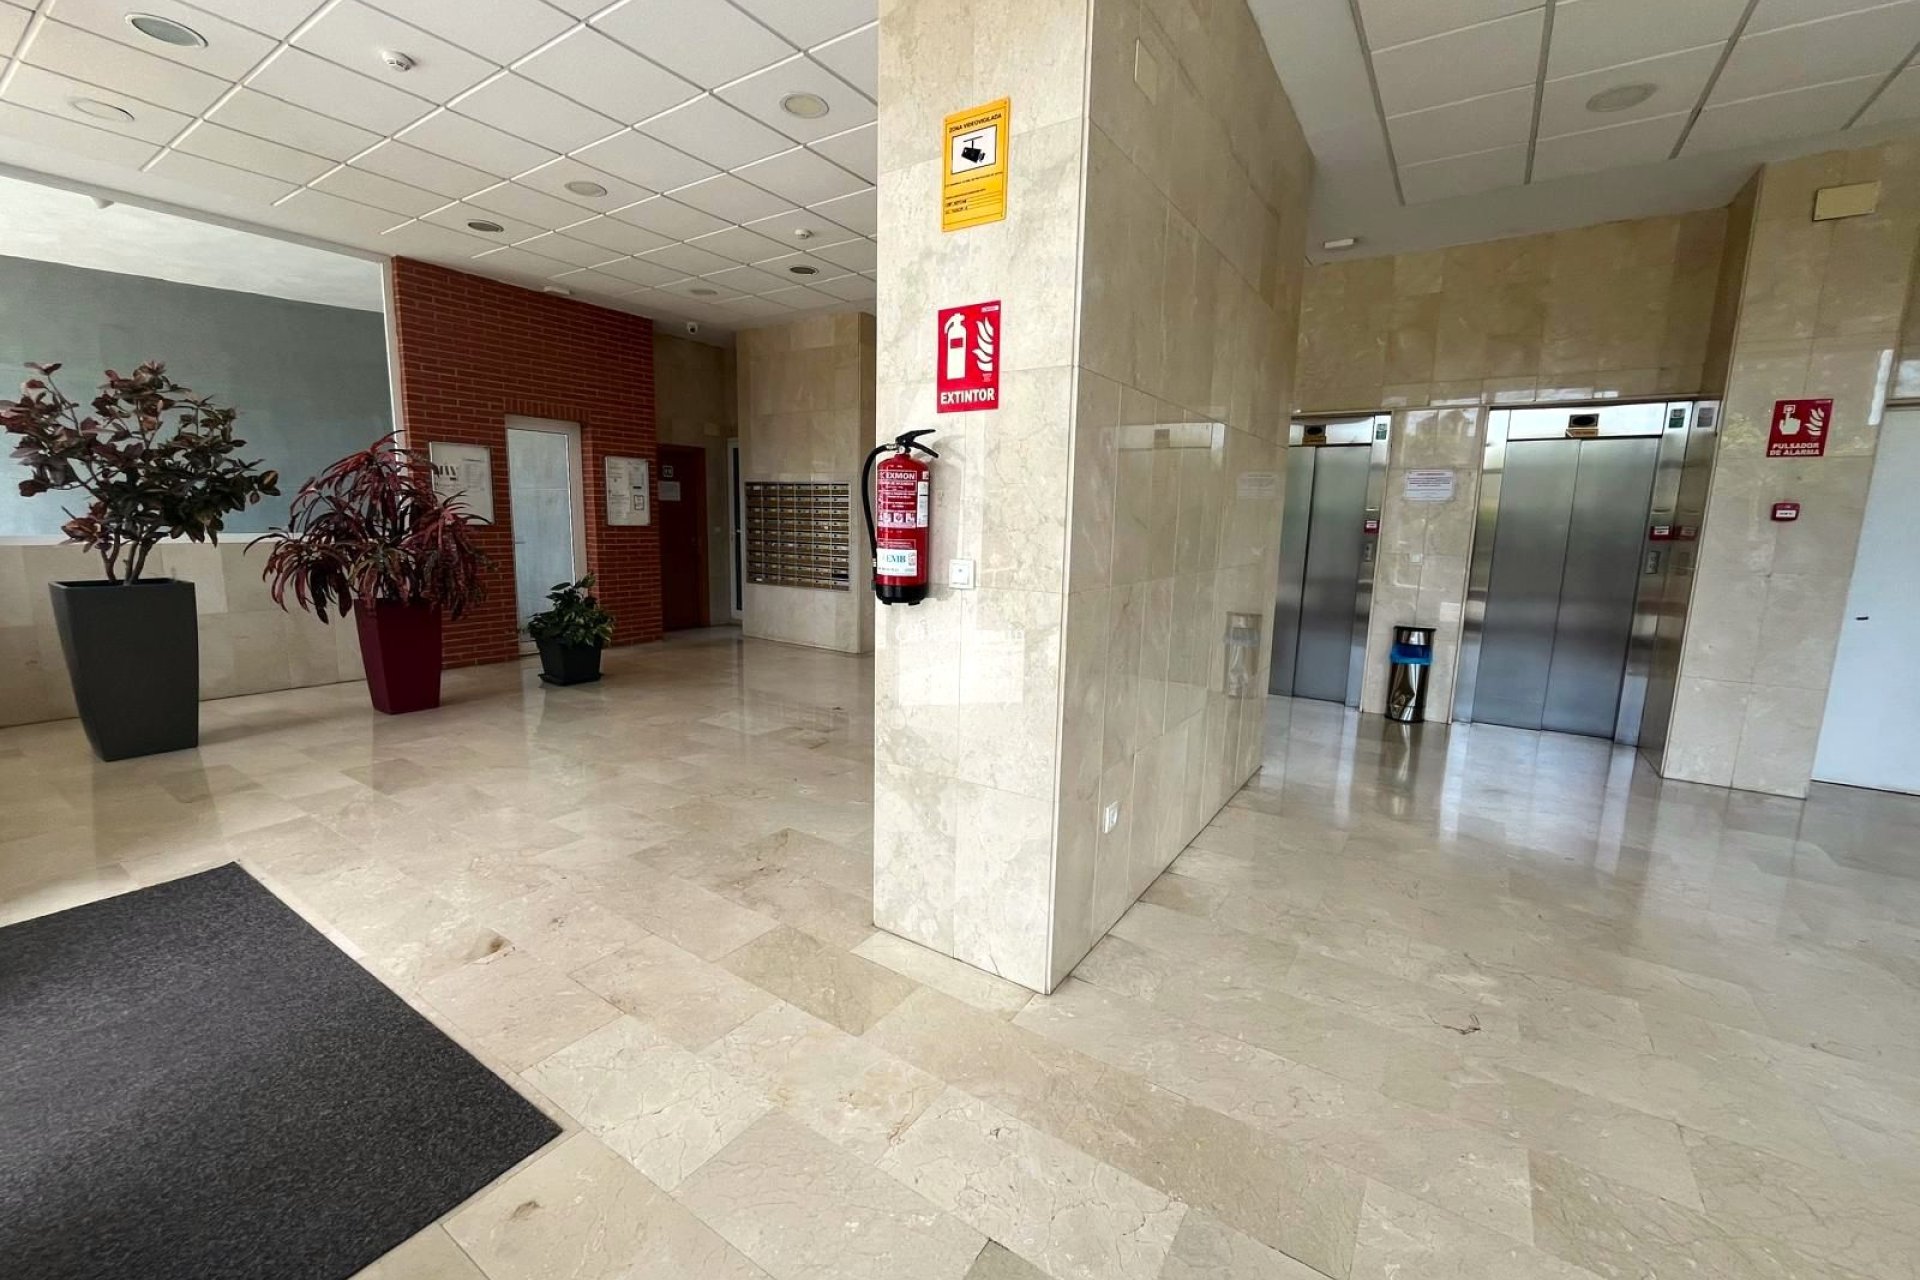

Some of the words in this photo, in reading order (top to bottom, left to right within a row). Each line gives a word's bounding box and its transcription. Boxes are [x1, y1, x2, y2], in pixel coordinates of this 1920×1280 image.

[949, 124, 963, 133] ZONA
[963, 113, 1002, 128] VIDEOVIGILADA
[940, 387, 995, 405] EXTINTOR
